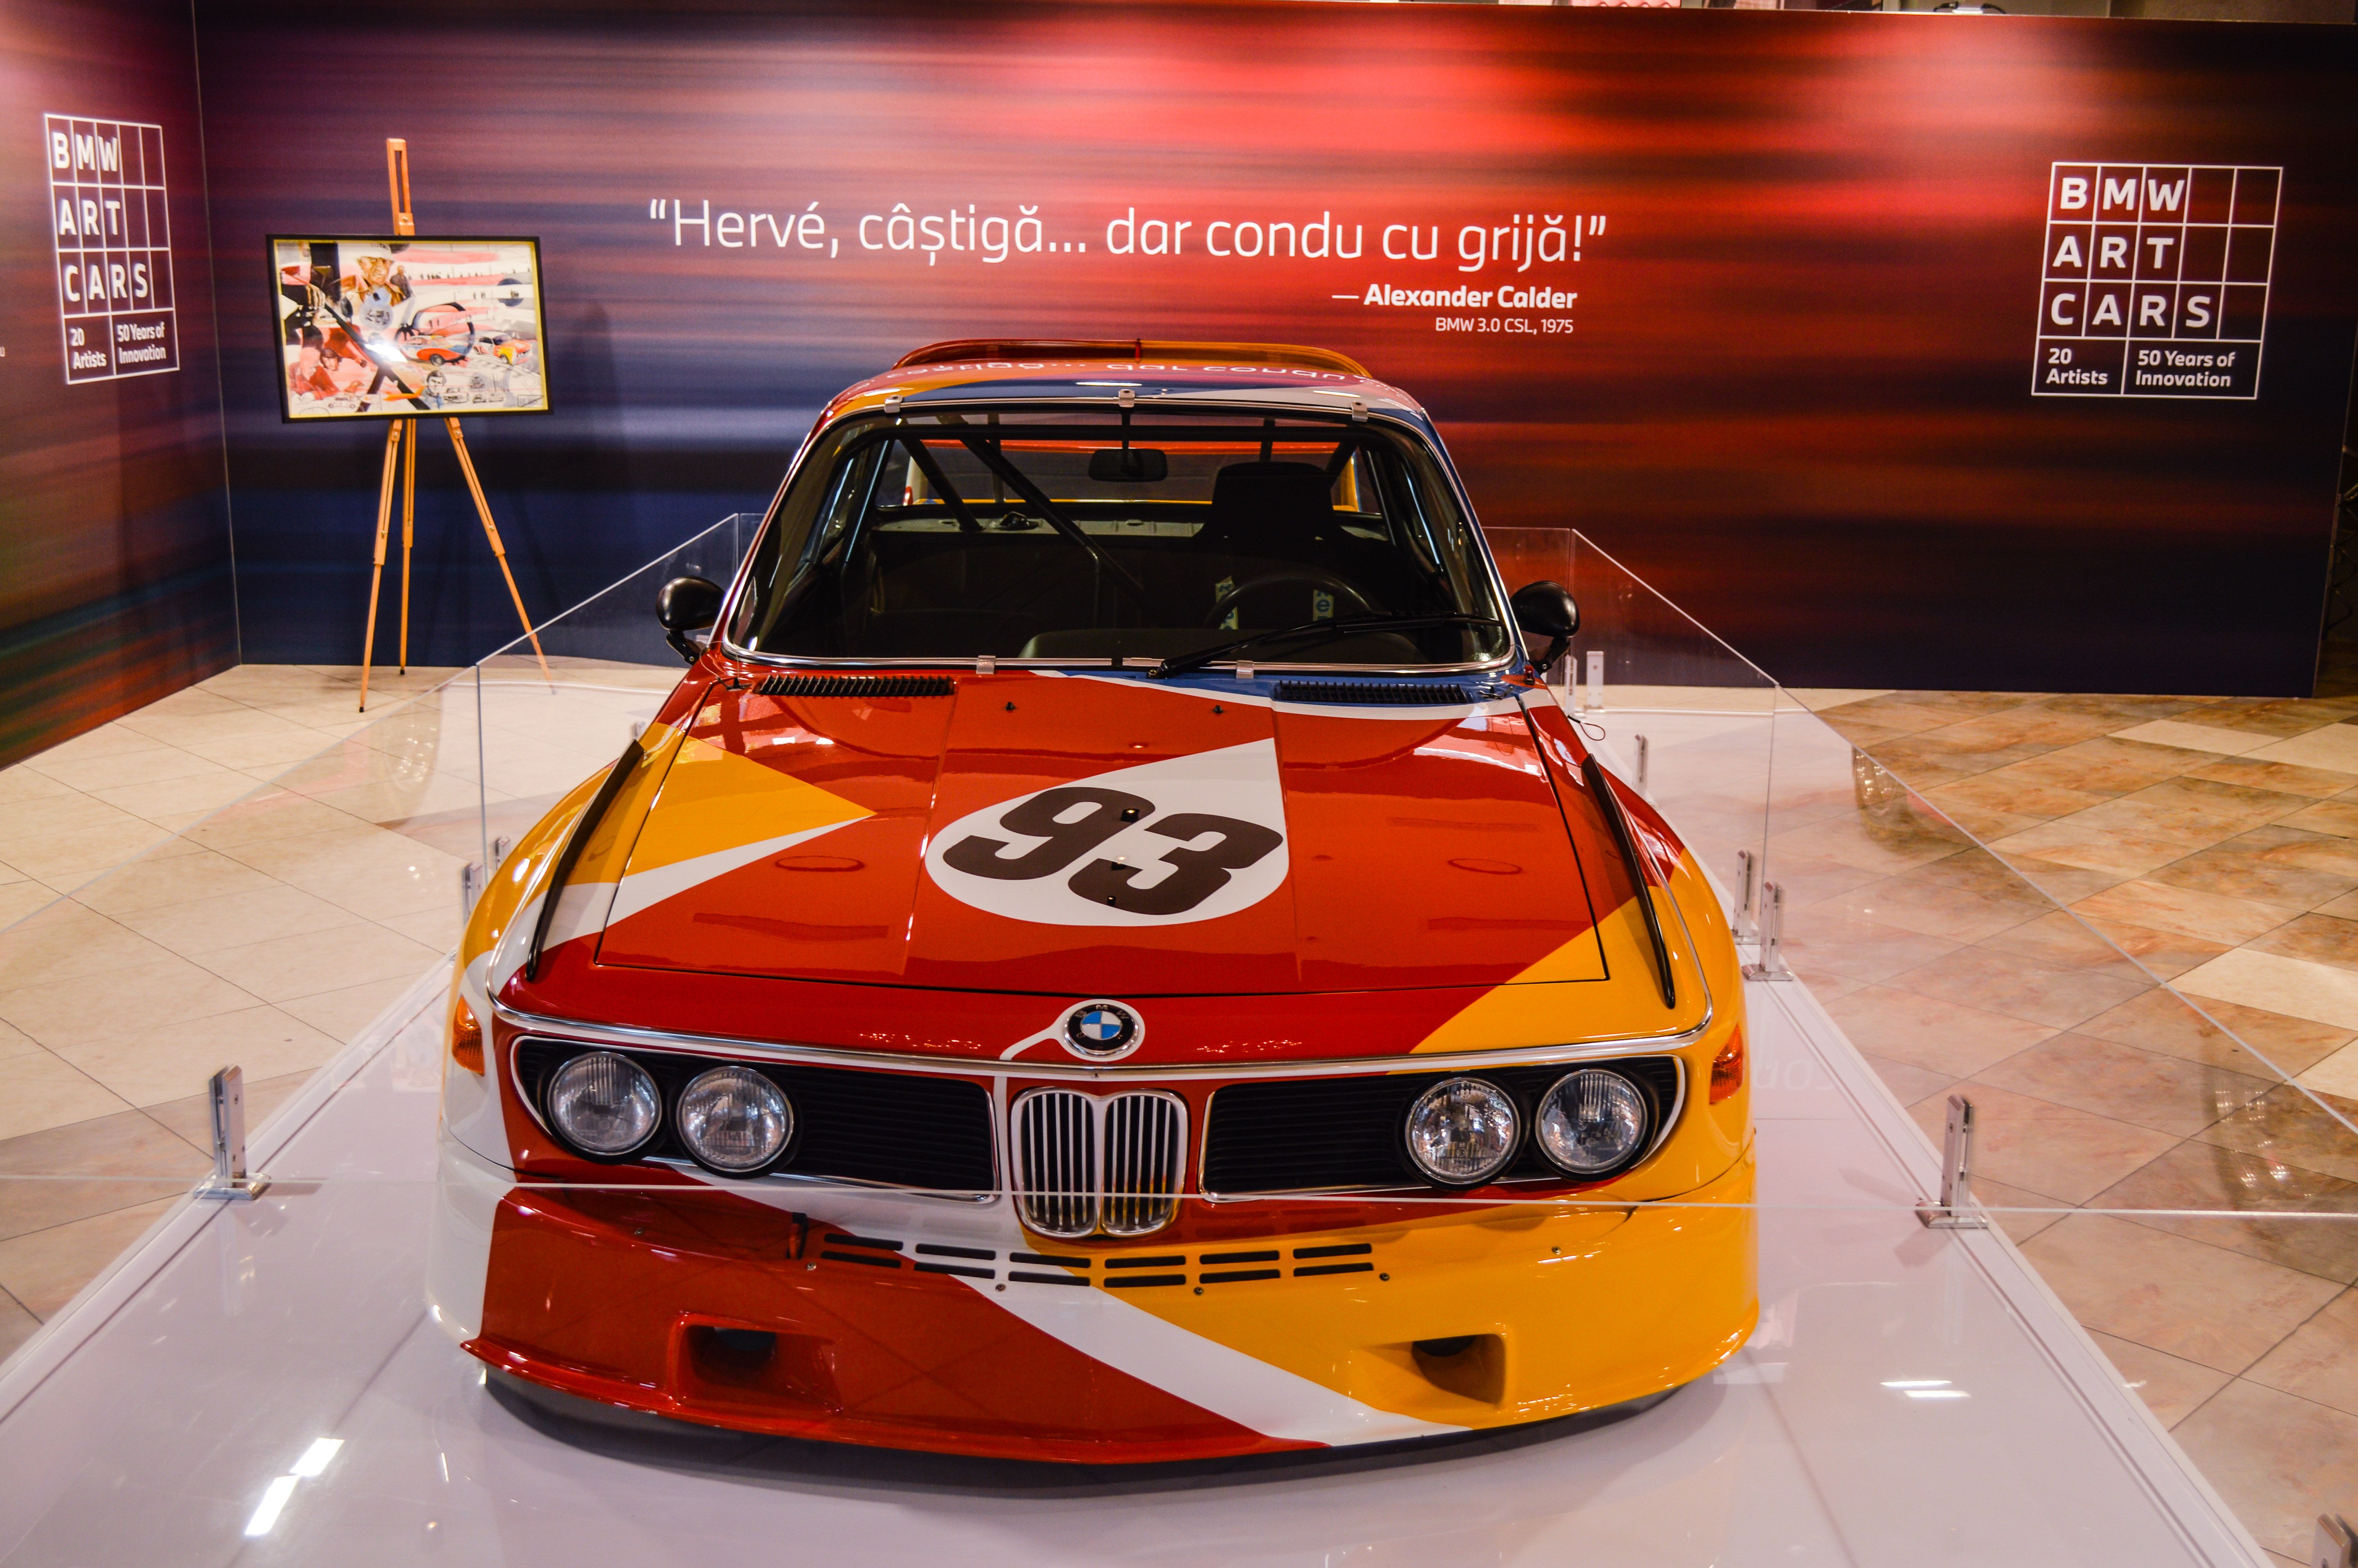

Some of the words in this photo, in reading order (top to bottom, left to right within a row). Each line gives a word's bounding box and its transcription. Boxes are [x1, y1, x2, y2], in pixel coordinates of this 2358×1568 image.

[52, 132, 119, 172] BMW
[2060, 177, 2185, 211] BMW
[59, 199, 121, 236] ART
[1106, 207, 1192, 255] dar
[1206, 210, 1363, 259] condu
[1383, 224, 1438, 260] cu
[2052, 236, 2174, 269] ART
[64, 263, 148, 302] CARS
[1363, 283, 1494, 308] Alexander
[1497, 285, 1578, 309] Calder
[2050, 293, 2211, 327] CARS
[117, 324, 130, 342] 50
[130, 323, 155, 341] Years
[155, 321, 165, 339] of
[1435, 317, 1475, 332] BMW
[1477, 317, 1501, 333] 3.0
[1504, 318, 1538, 335] CSL,
[1540, 318, 1574, 334] 1975
[70, 328, 85, 346] 20
[73, 350, 107, 369] Artists
[119, 344, 167, 364] Innovation
[2048, 348, 2072, 364] 20
[2138, 350, 2161, 366] 50
[2164, 350, 2214, 367] Years
[2216, 351, 2236, 367] of
[2045, 368, 2108, 385] Artists
[2135, 370, 2231, 387] Innovation
[942, 786, 1283, 916] 93
[1075, 1004, 1130, 1019] BMW
